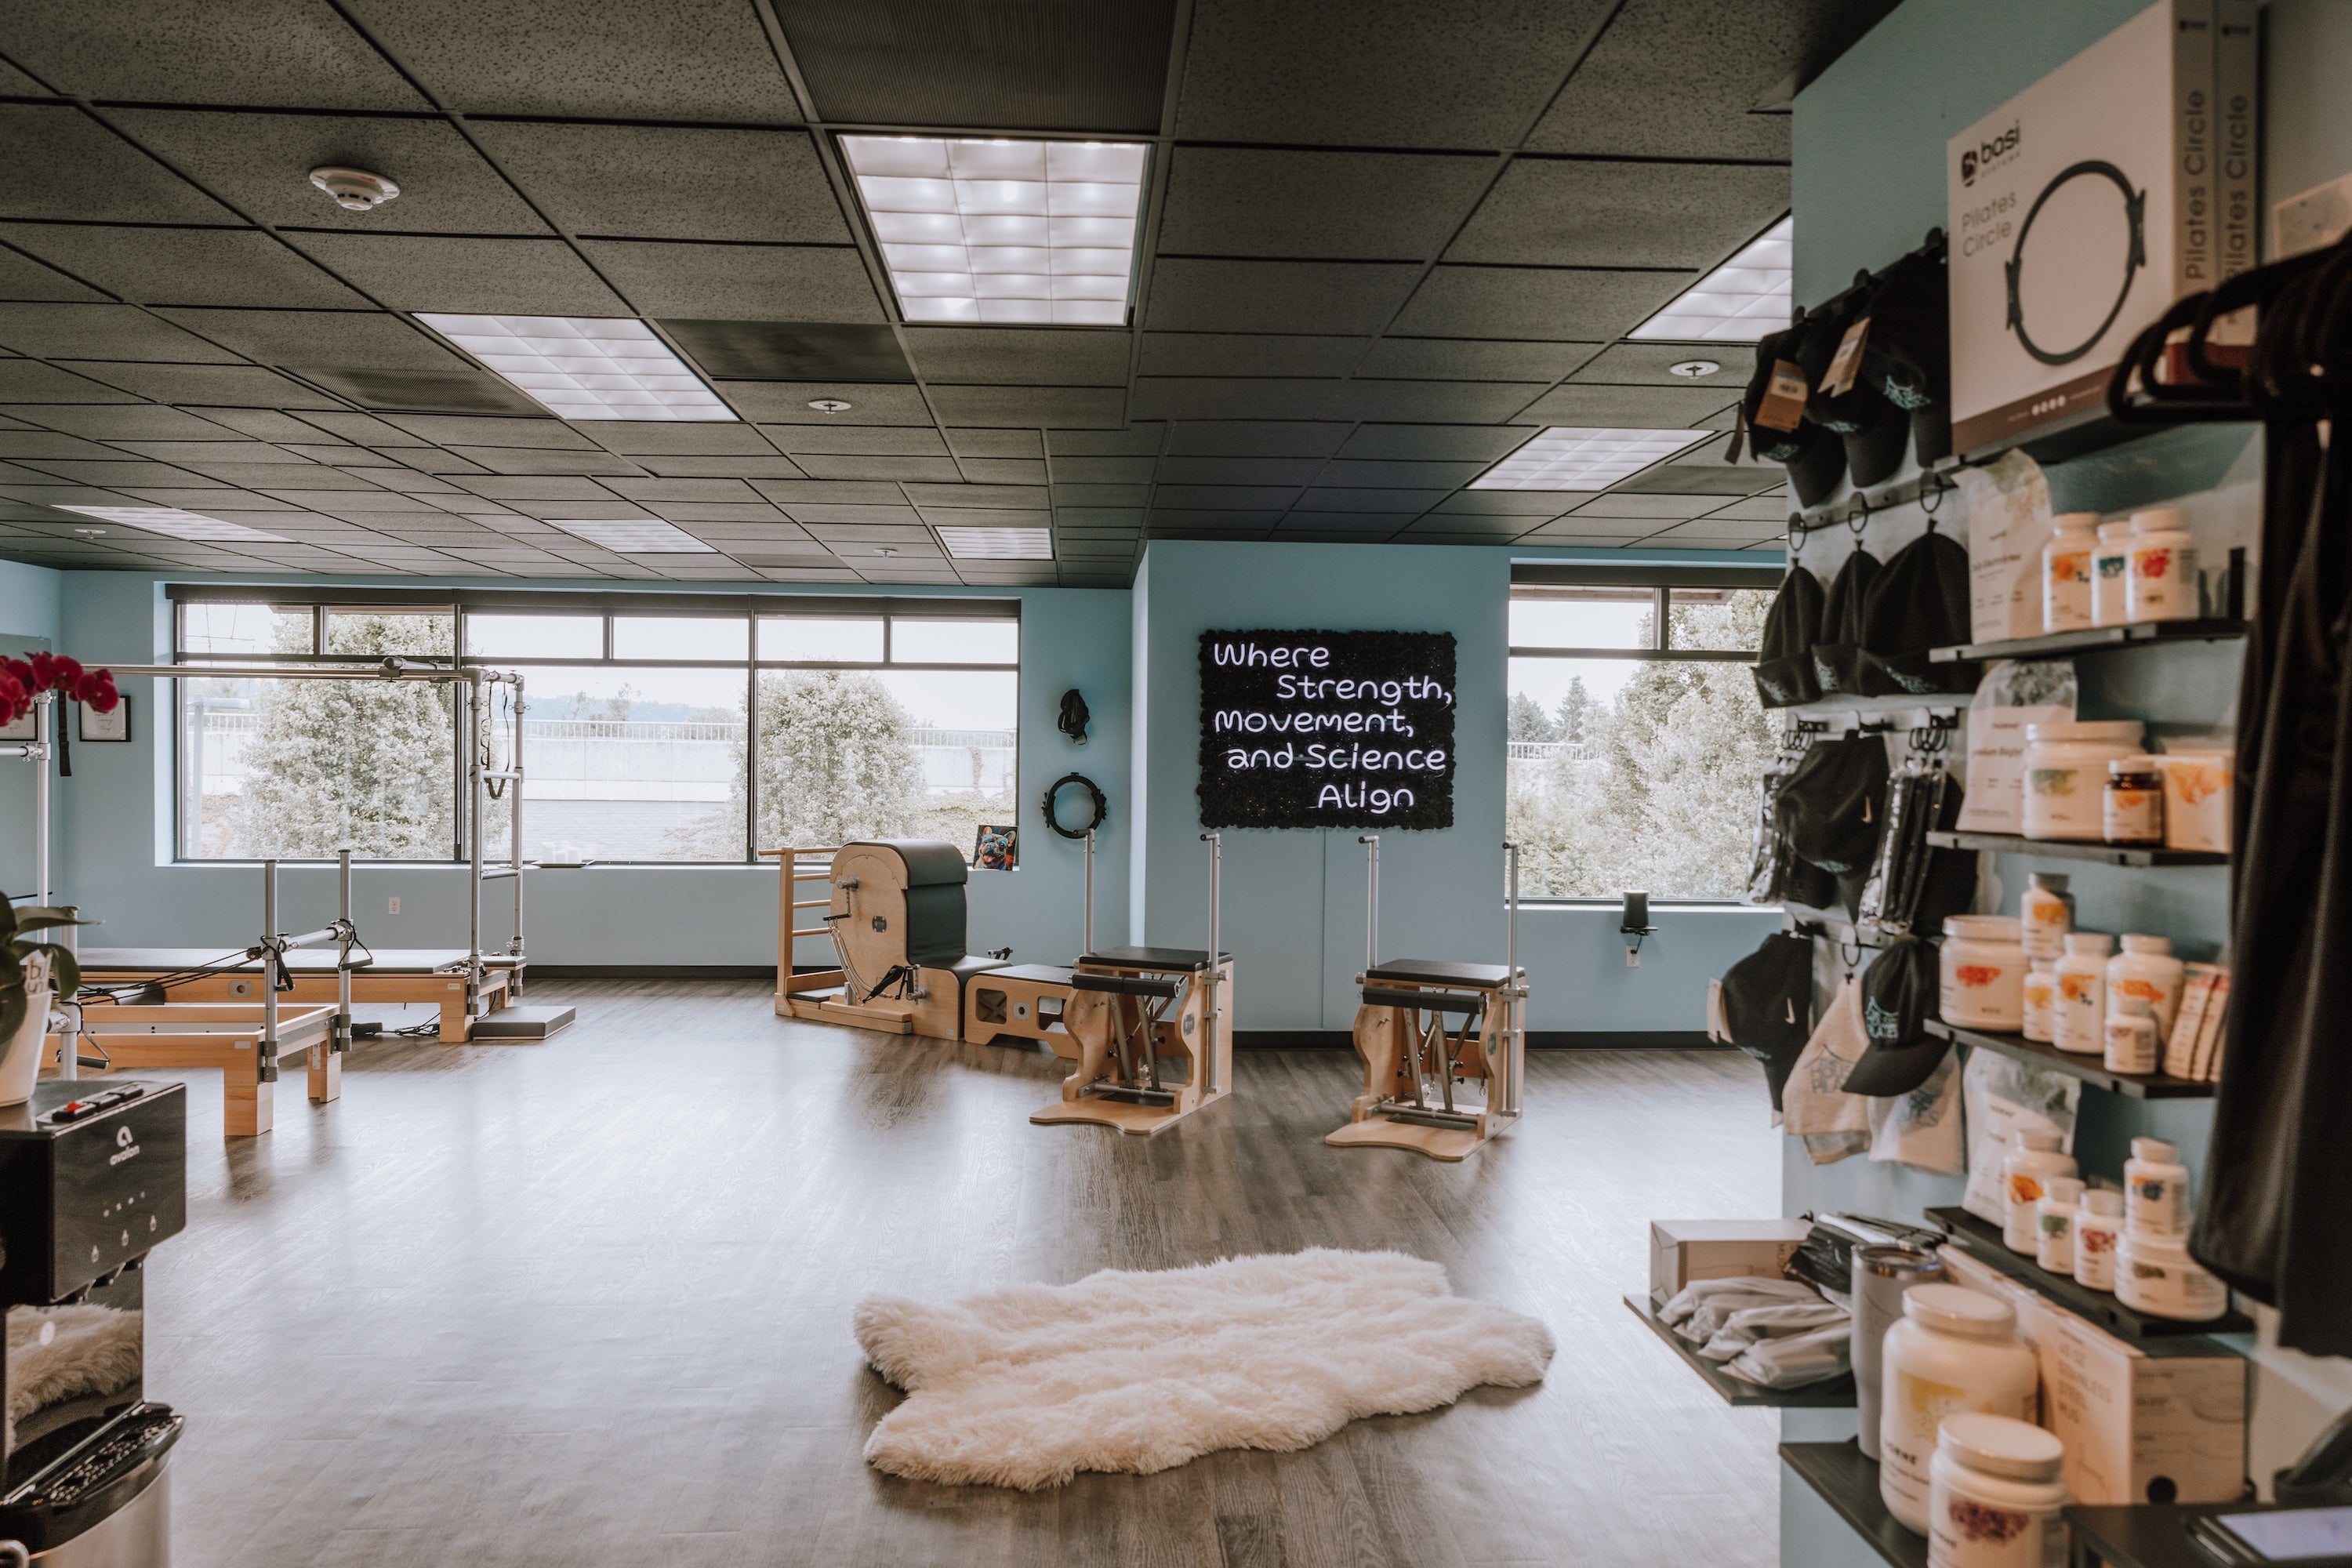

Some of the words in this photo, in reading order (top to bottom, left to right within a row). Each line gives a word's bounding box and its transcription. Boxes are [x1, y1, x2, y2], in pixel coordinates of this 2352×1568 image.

[2184, 90, 2206, 176] Circle
[2225, 94, 2249, 180] Circle
[1962, 191, 2016, 233] Pilates
[1962, 220, 2012, 257] Circle
[2185, 186, 2206, 279] Pilates
[1214, 642, 1330, 667] Where
[1276, 674, 1453, 706] Strength,
[1214, 708, 1414, 738] Movement,
[1227, 742, 1294, 769] and
[1305, 742, 1446, 771] Science
[1317, 780, 1414, 815] Align
[110, 1145, 140, 1166] avalon
